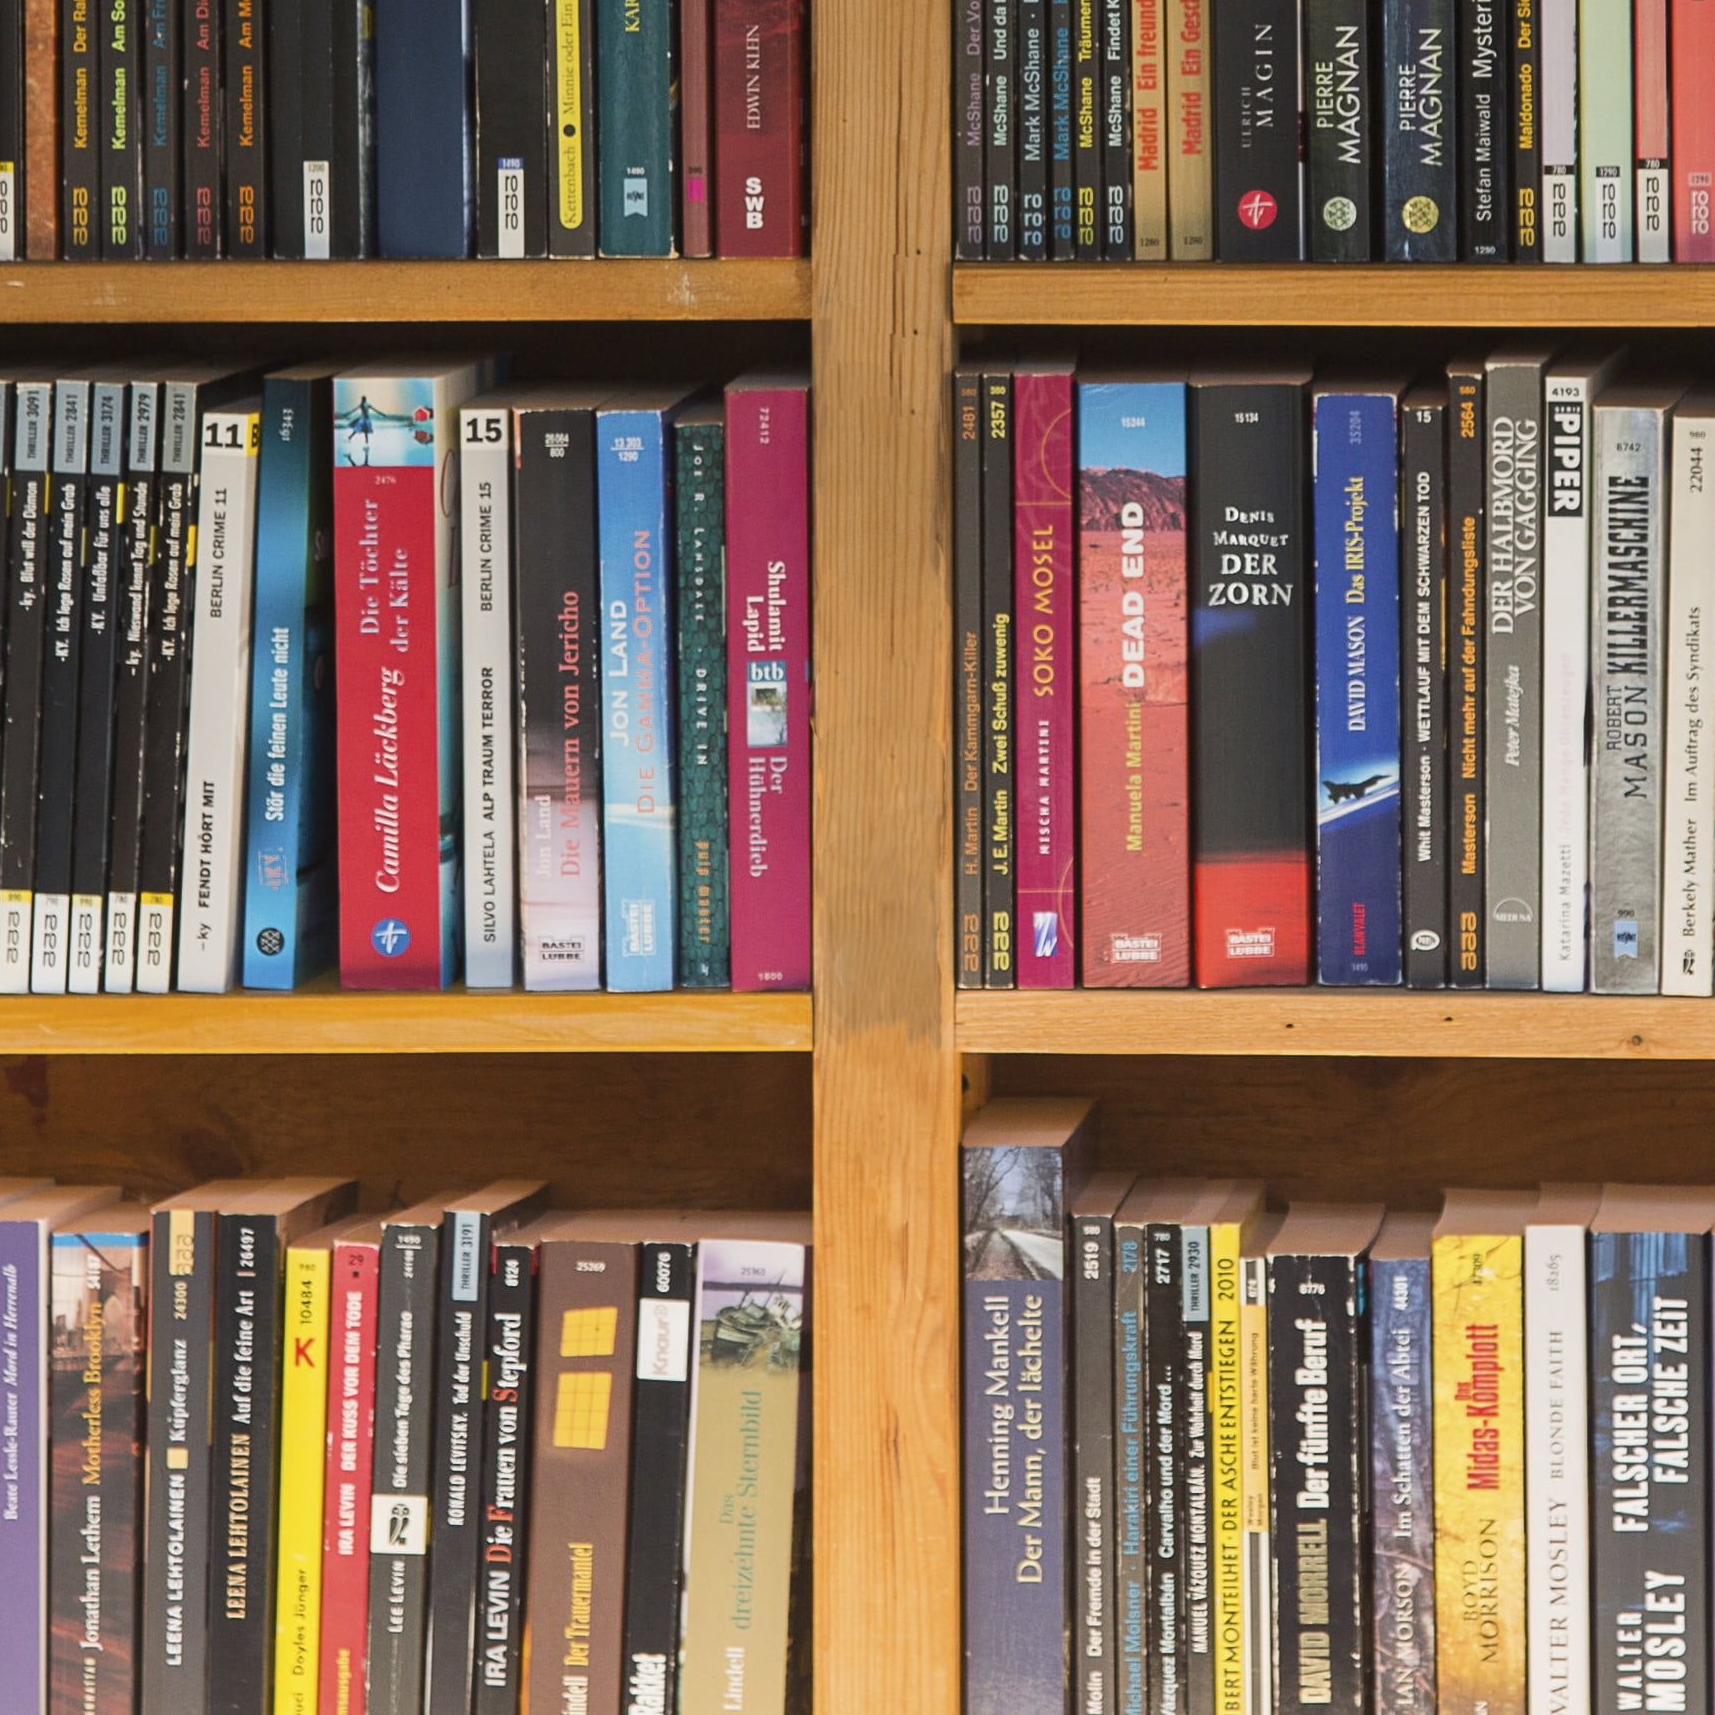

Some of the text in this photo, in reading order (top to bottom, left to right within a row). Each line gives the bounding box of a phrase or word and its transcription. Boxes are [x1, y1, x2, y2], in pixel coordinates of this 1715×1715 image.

[1399, 63, 1417, 130] PIERRE
[1418, 28, 1444, 166] MAGNAN
[204, 422, 245, 449] 11
[465, 418, 502, 442] 15
[1551, 387, 1579, 397] 4193
[1552, 412, 1581, 512] PIPER
[1122, 501, 1146, 688] DEAD END
[1209, 581, 1292, 607] ZORN
[1220, 551, 1278, 577] DER
[1607, 474, 1649, 677] KILLERMASCHINE
[751, 662, 785, 682] btb
[375, 668, 404, 892] Camilla Läckberg
[983, 1295, 1012, 1515] Henning Mankell
[1467, 1323, 1503, 1492] Midas-Komplott
[1613, 1323, 1648, 1533] FALSCHER ORT,
[1653, 1296, 1689, 1483] FALSCHE ZEIT
[166, 1473, 184, 1665] LEENA LEHTOLAINEN
[484, 1571, 508, 1688] IRA LEVIN
